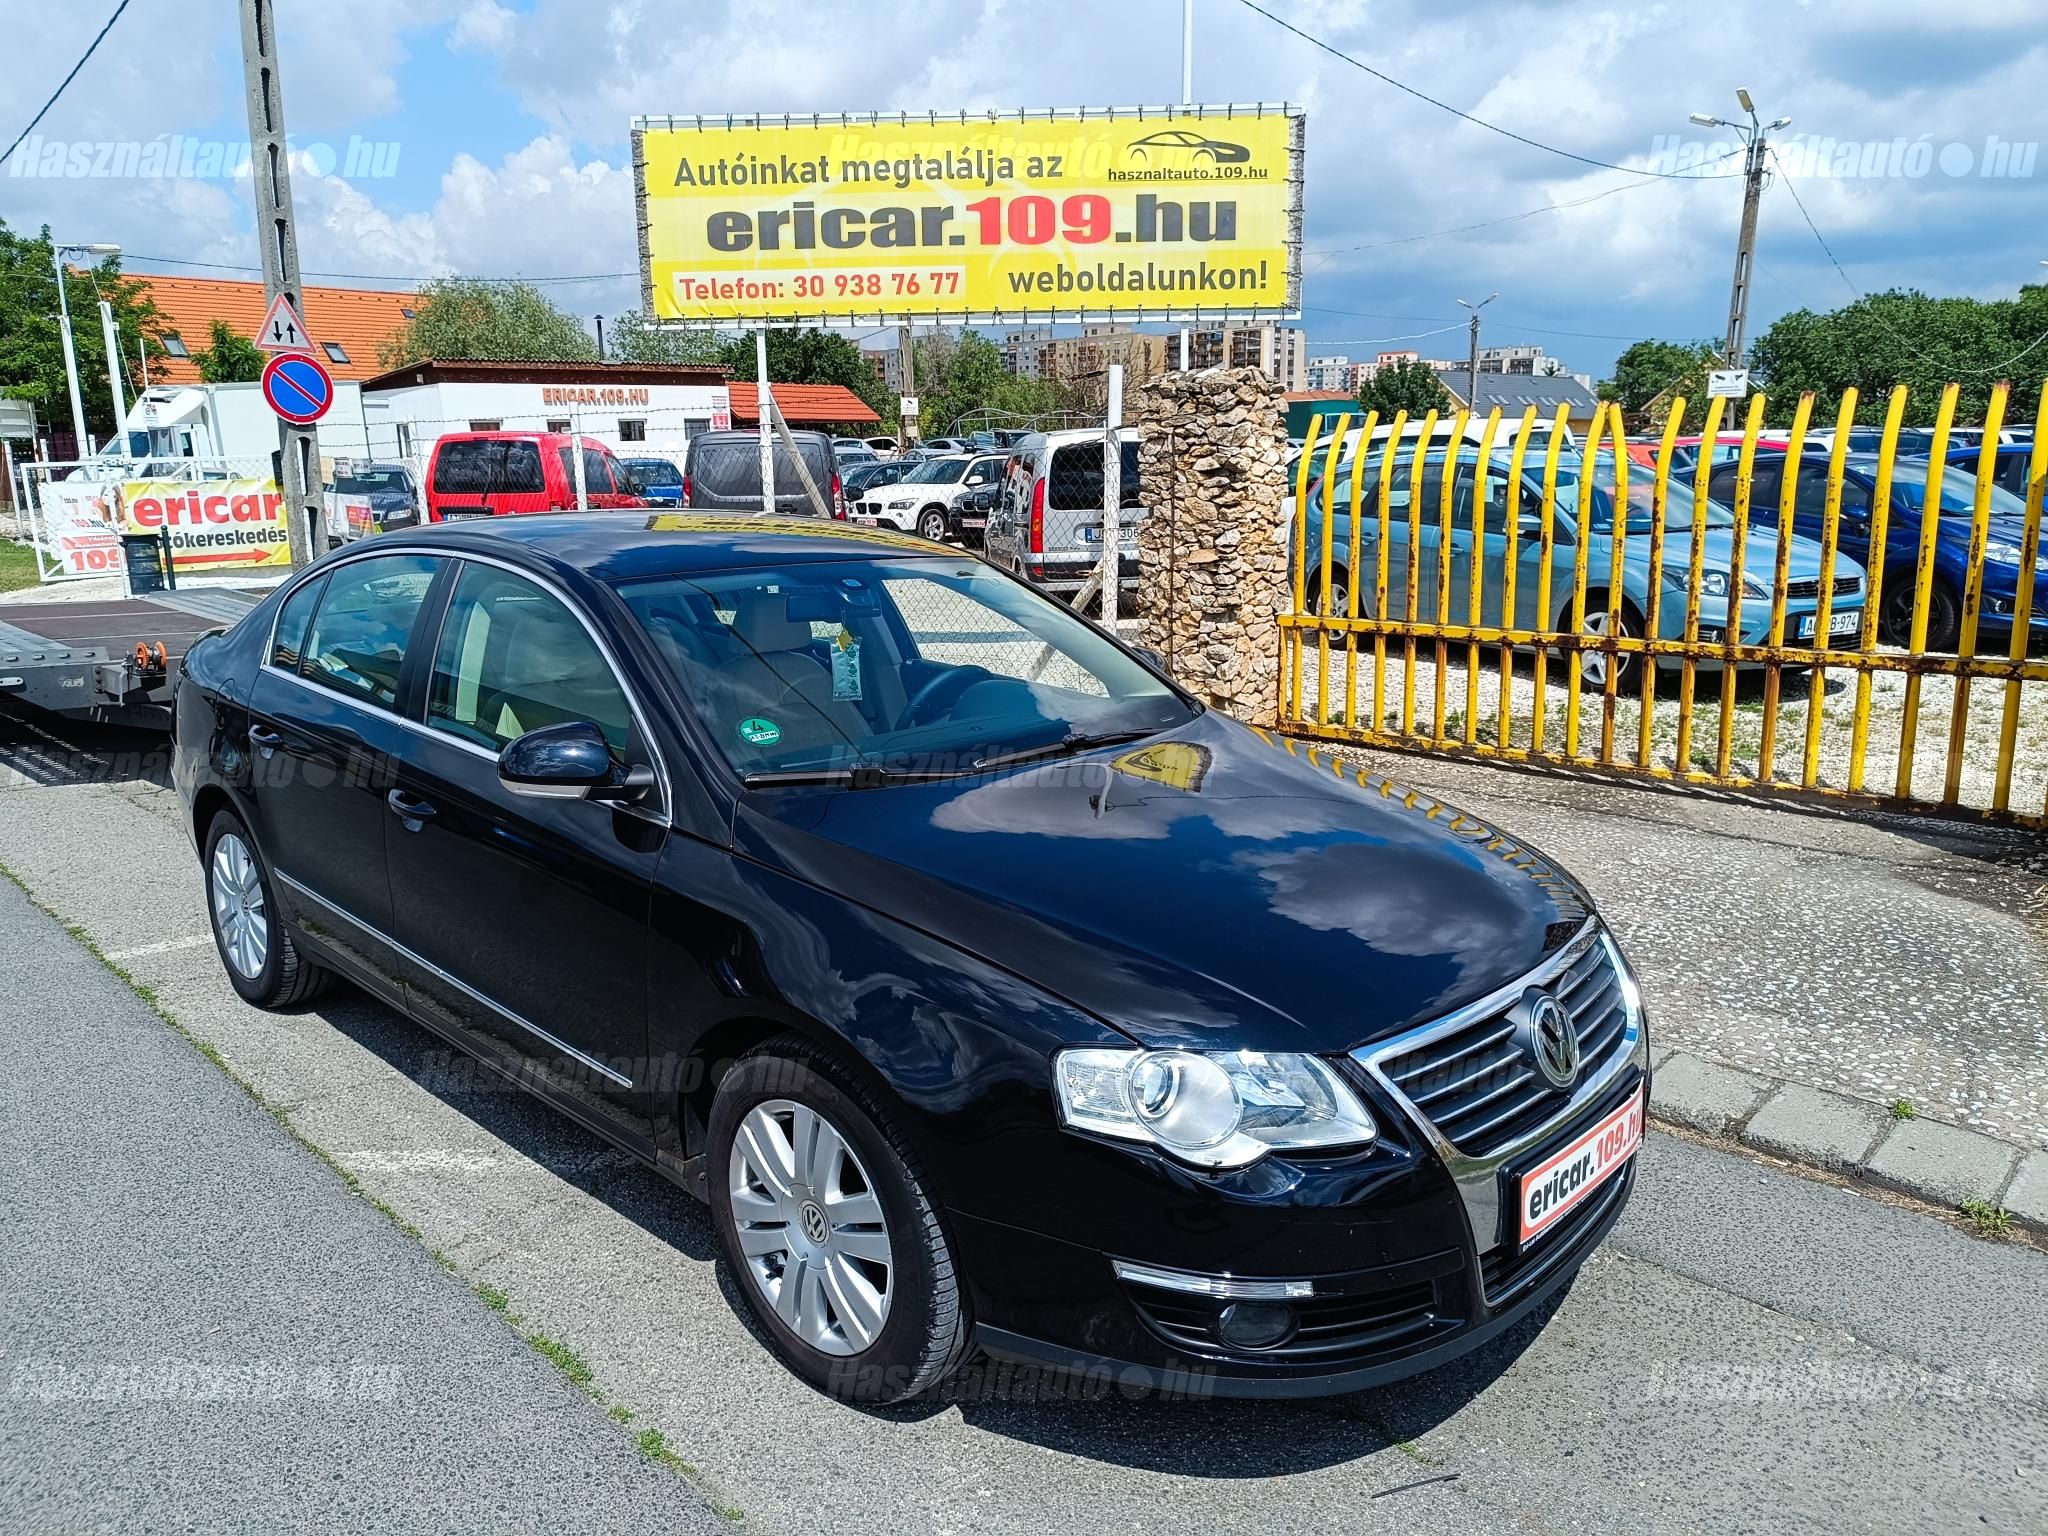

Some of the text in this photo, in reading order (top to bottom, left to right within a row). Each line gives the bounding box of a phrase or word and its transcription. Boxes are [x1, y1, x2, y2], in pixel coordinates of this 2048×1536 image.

[674, 146, 1062, 188] Autóinkat megtalálja az
[1107, 165, 1269, 180] hasznaltauto.109.hu
[706, 193, 1237, 252] ericar.109.hu
[679, 272, 959, 300] Telefon: 30 938 76 77
[1008, 260, 1267, 292] weboldalunkon!
[543, 387, 649, 406] ERICAR.109.HU
[133, 491, 282, 527] ericar
[1528, 1104, 1644, 1221] ericar.109.hu
